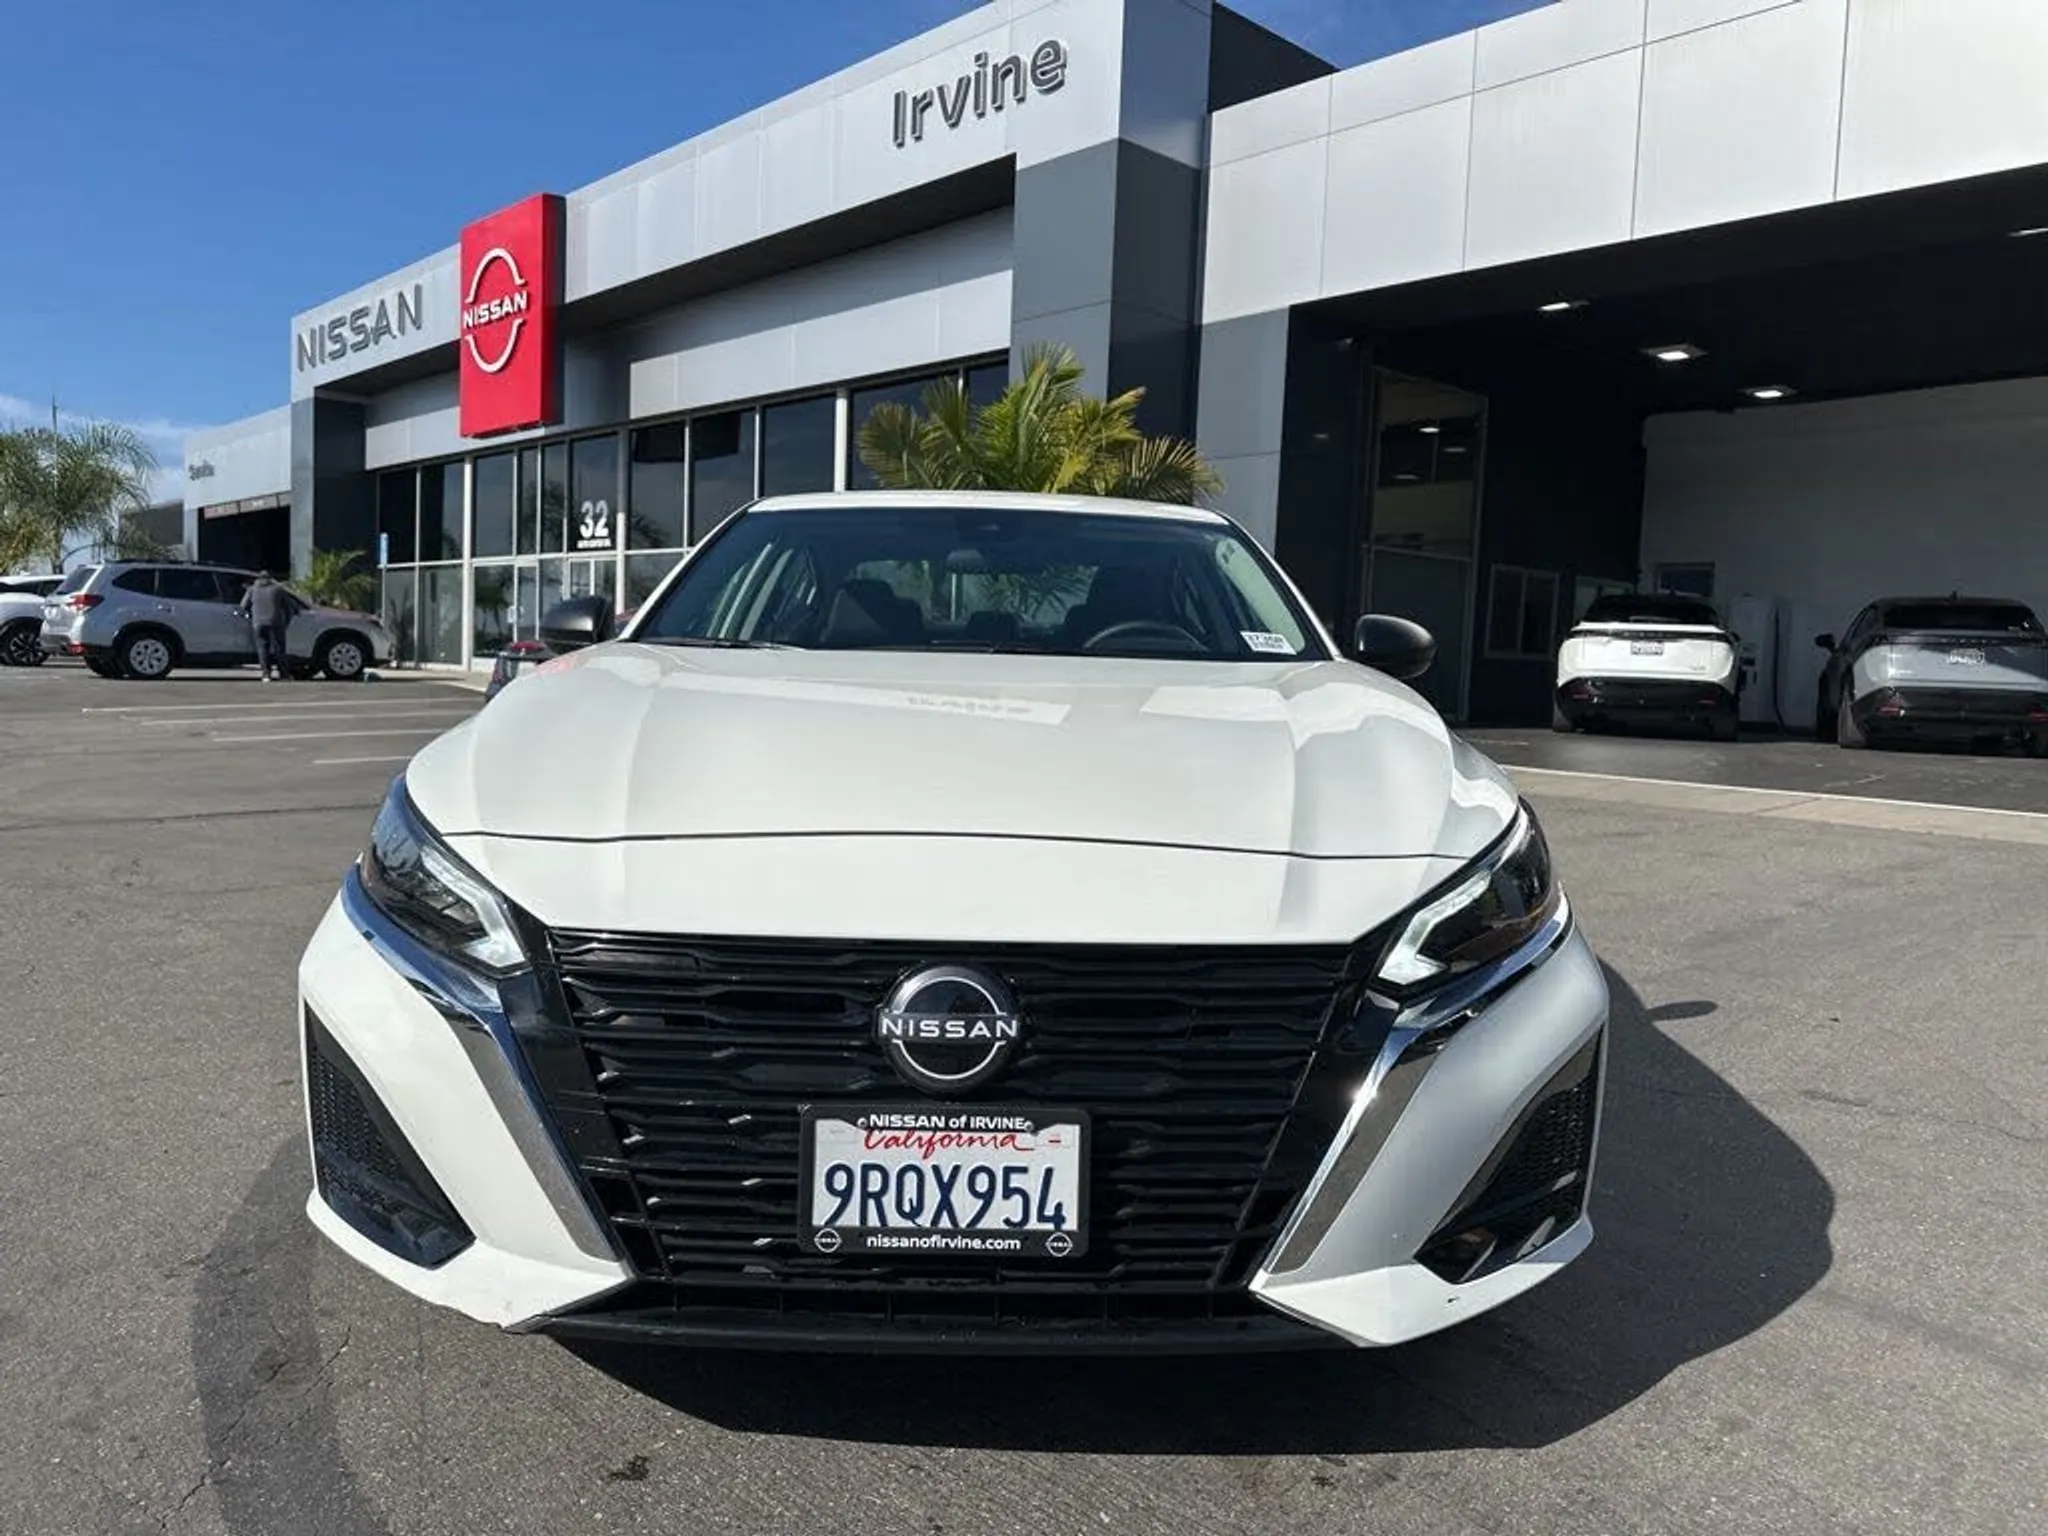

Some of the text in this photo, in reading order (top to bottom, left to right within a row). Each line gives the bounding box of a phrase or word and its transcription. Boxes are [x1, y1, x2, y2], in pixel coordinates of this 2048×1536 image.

[893, 39, 1068, 148] Irvine
[297, 284, 423, 372] NISSAN
[463, 291, 528, 329] NISSAN
[580, 500, 610, 538] 32
[882, 1018, 1017, 1037] NISSAN
[869, 1114, 1025, 1130] NISSAN of IRVINE
[863, 1129, 1035, 1160] California
[823, 1162, 1067, 1229] 9RQX954
[867, 1234, 1021, 1250] nissanofirvine.com
